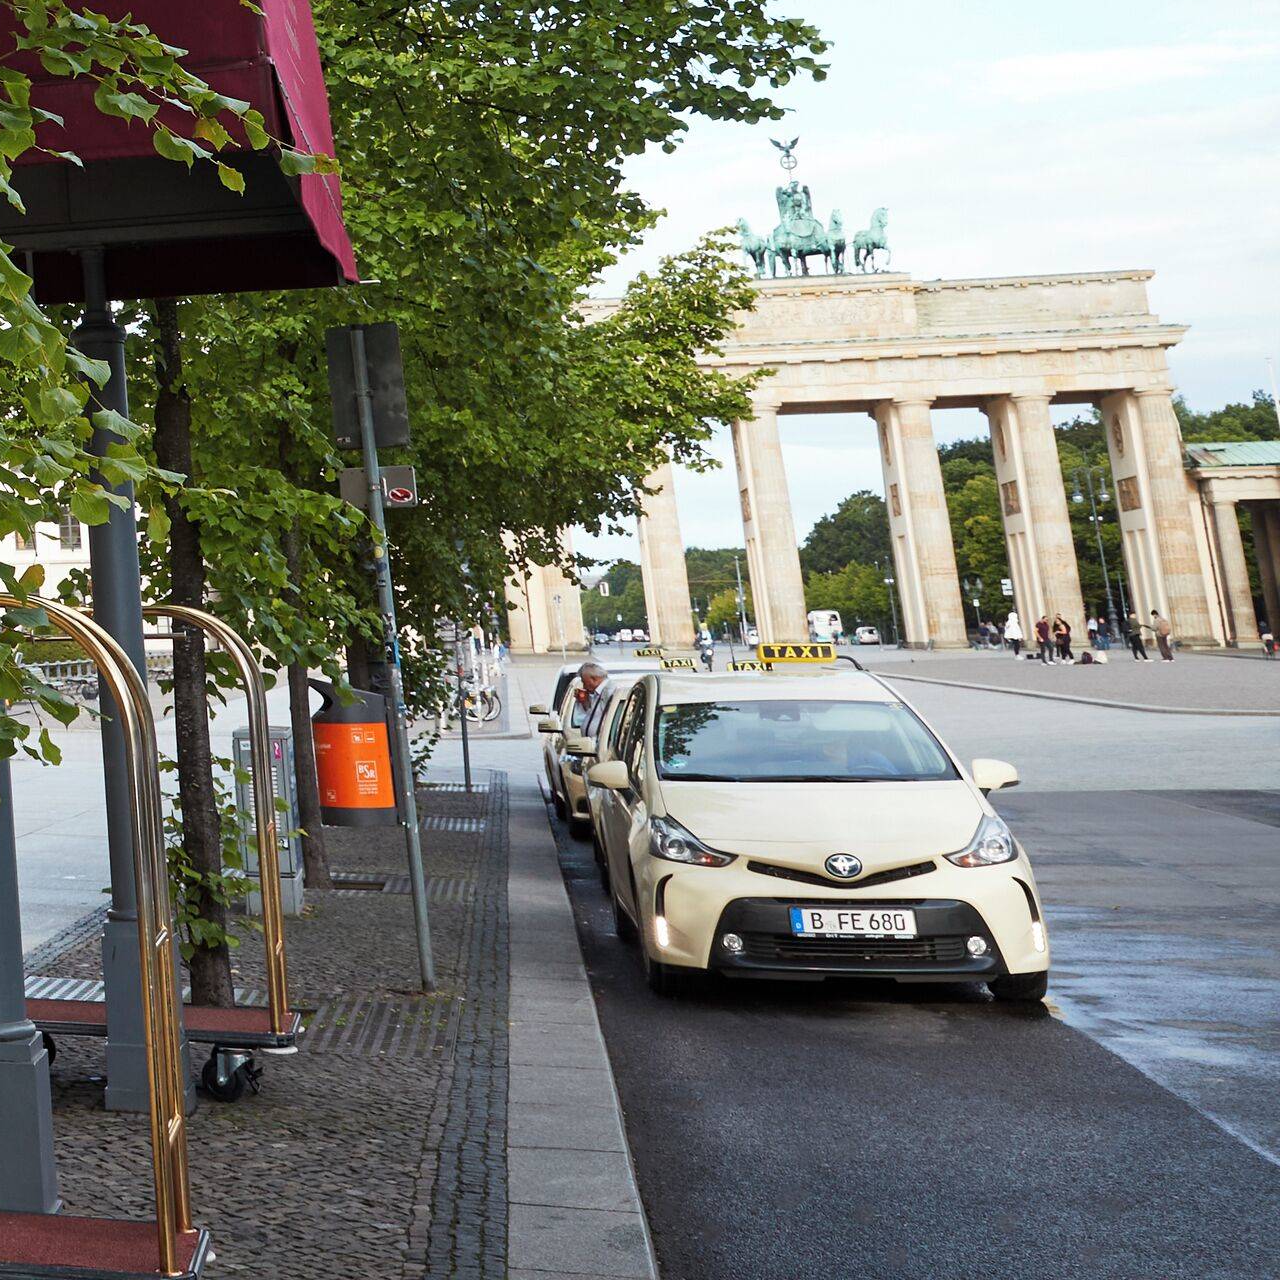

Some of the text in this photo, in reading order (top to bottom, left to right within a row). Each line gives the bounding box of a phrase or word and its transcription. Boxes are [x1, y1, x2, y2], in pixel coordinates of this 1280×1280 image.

[771, 646, 824, 658] TAXI
[667, 659, 692, 667] TAXI
[736, 661, 767, 671] TAXI
[358, 764, 376, 779] BSR
[810, 912, 906, 931] B FE 680
